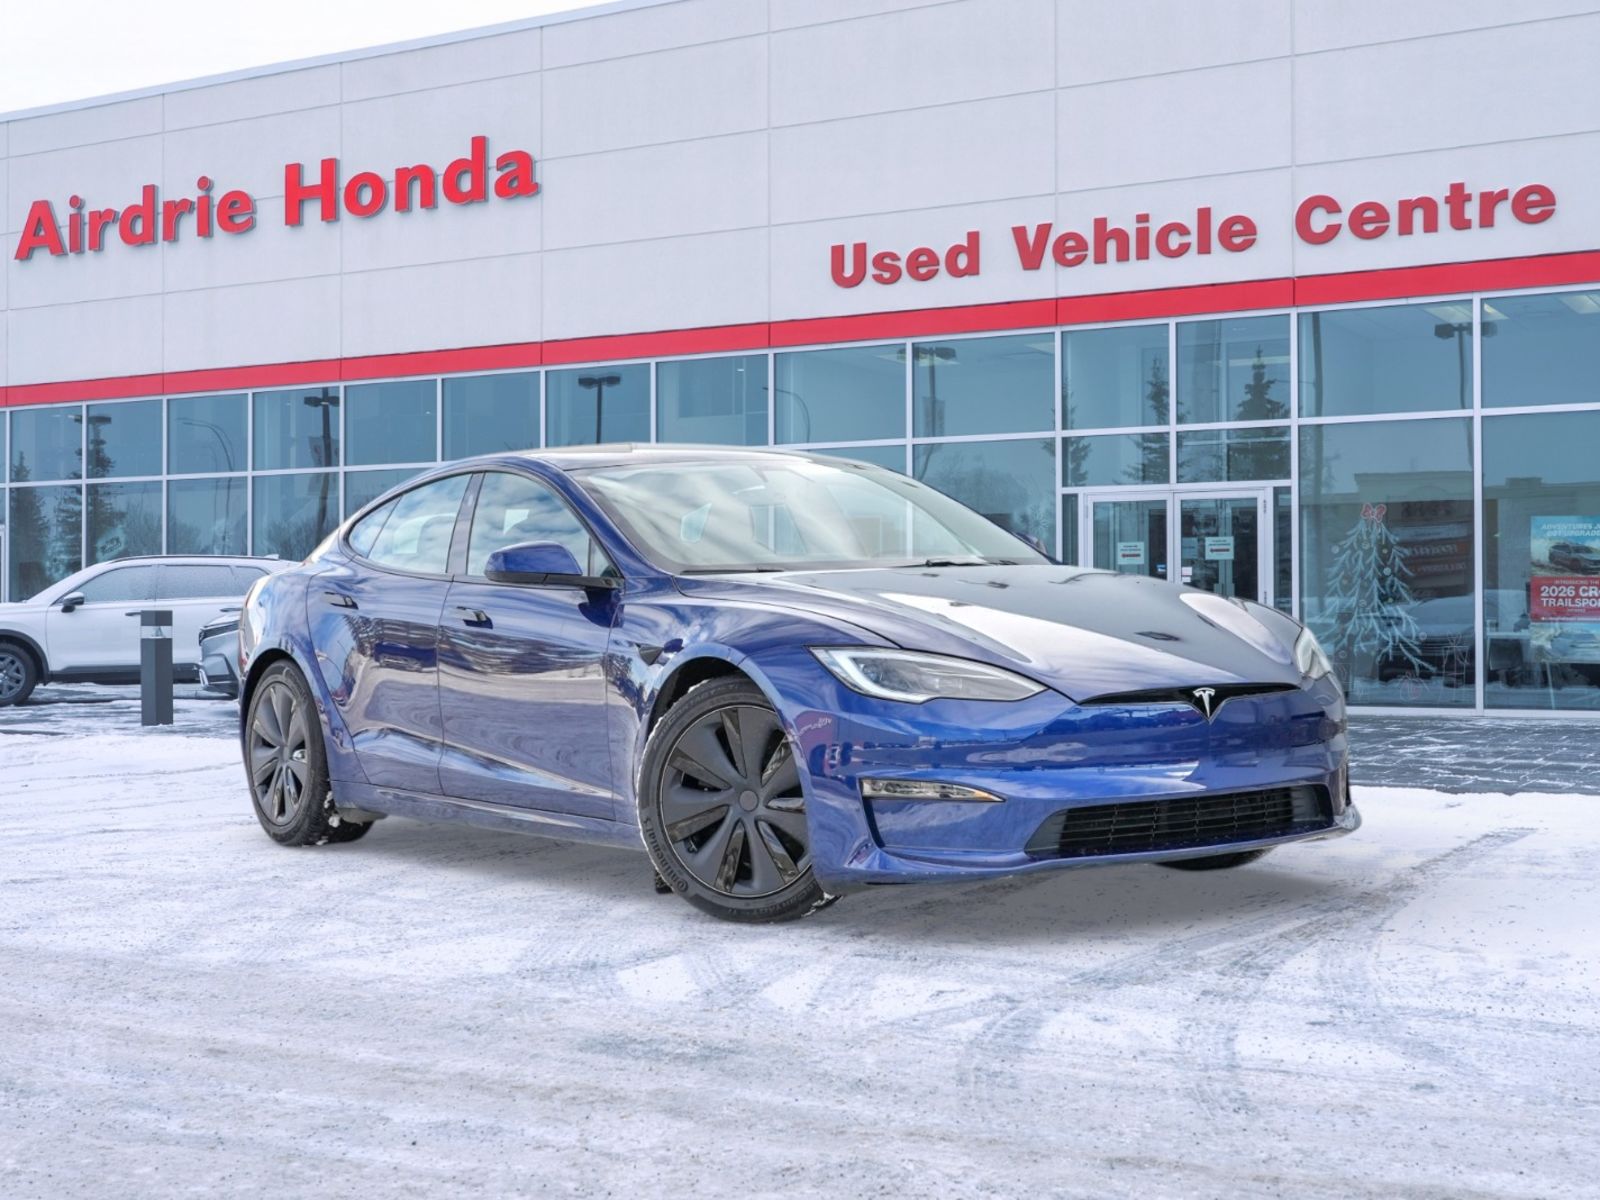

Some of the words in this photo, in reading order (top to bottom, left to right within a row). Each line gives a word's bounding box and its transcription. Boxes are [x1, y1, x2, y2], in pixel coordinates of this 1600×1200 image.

[15, 176, 254, 260] Airdrie
[284, 136, 539, 226] Honda
[831, 231, 980, 288] Used
[1012, 207, 1257, 270] Vehicle
[1296, 183, 1556, 244] Centre
[1540, 586, 1576, 597] 2026
[1540, 598, 1600, 608] TRAILSPO
[645, 827, 689, 893] Continental
